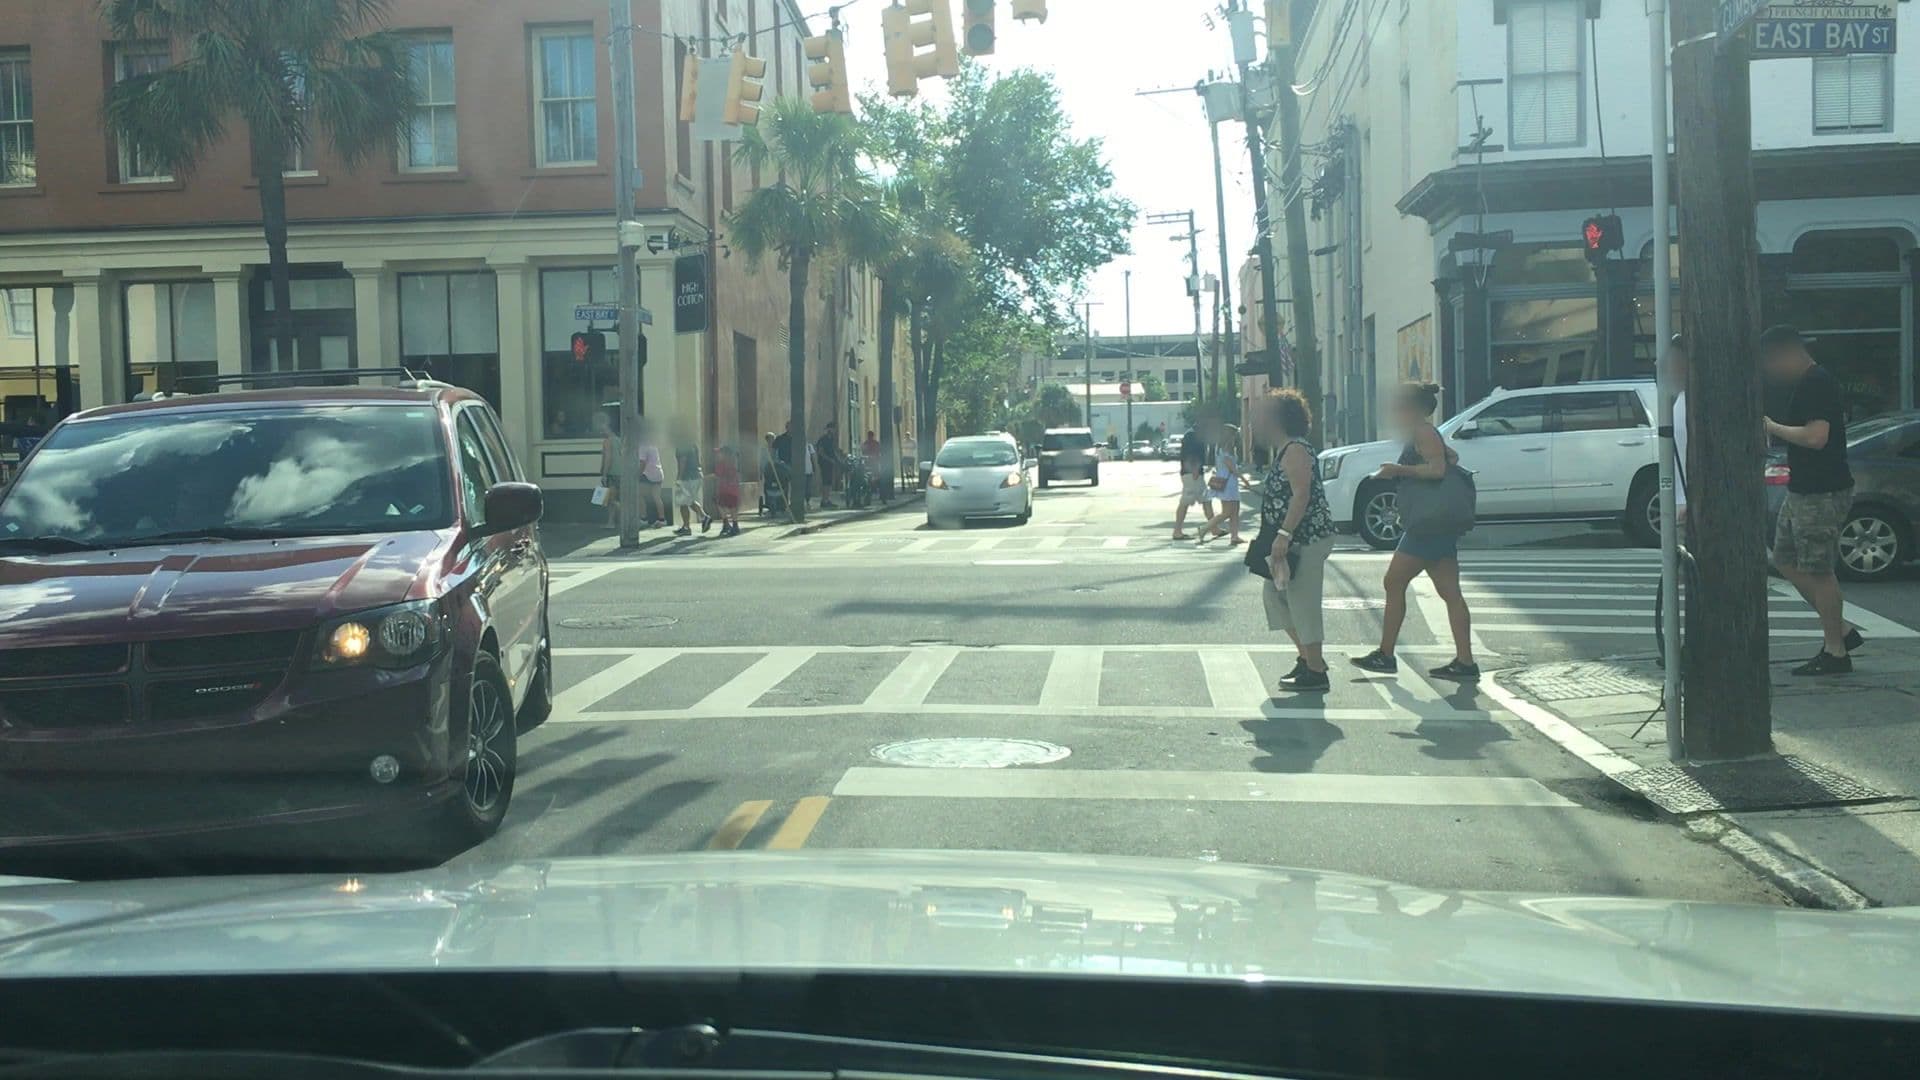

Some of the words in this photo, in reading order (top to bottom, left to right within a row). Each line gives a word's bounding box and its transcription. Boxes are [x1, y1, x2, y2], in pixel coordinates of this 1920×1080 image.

[1775, 9, 1817, 17] FRENCH
[1824, 9, 1871, 18] QUARTER
[1756, 23, 1815, 49] EAST
[1826, 23, 1870, 49] BAY
[1872, 27, 1889, 44] ST
[576, 310, 594, 320] EAST
[195, 683, 255, 694] DODGE
